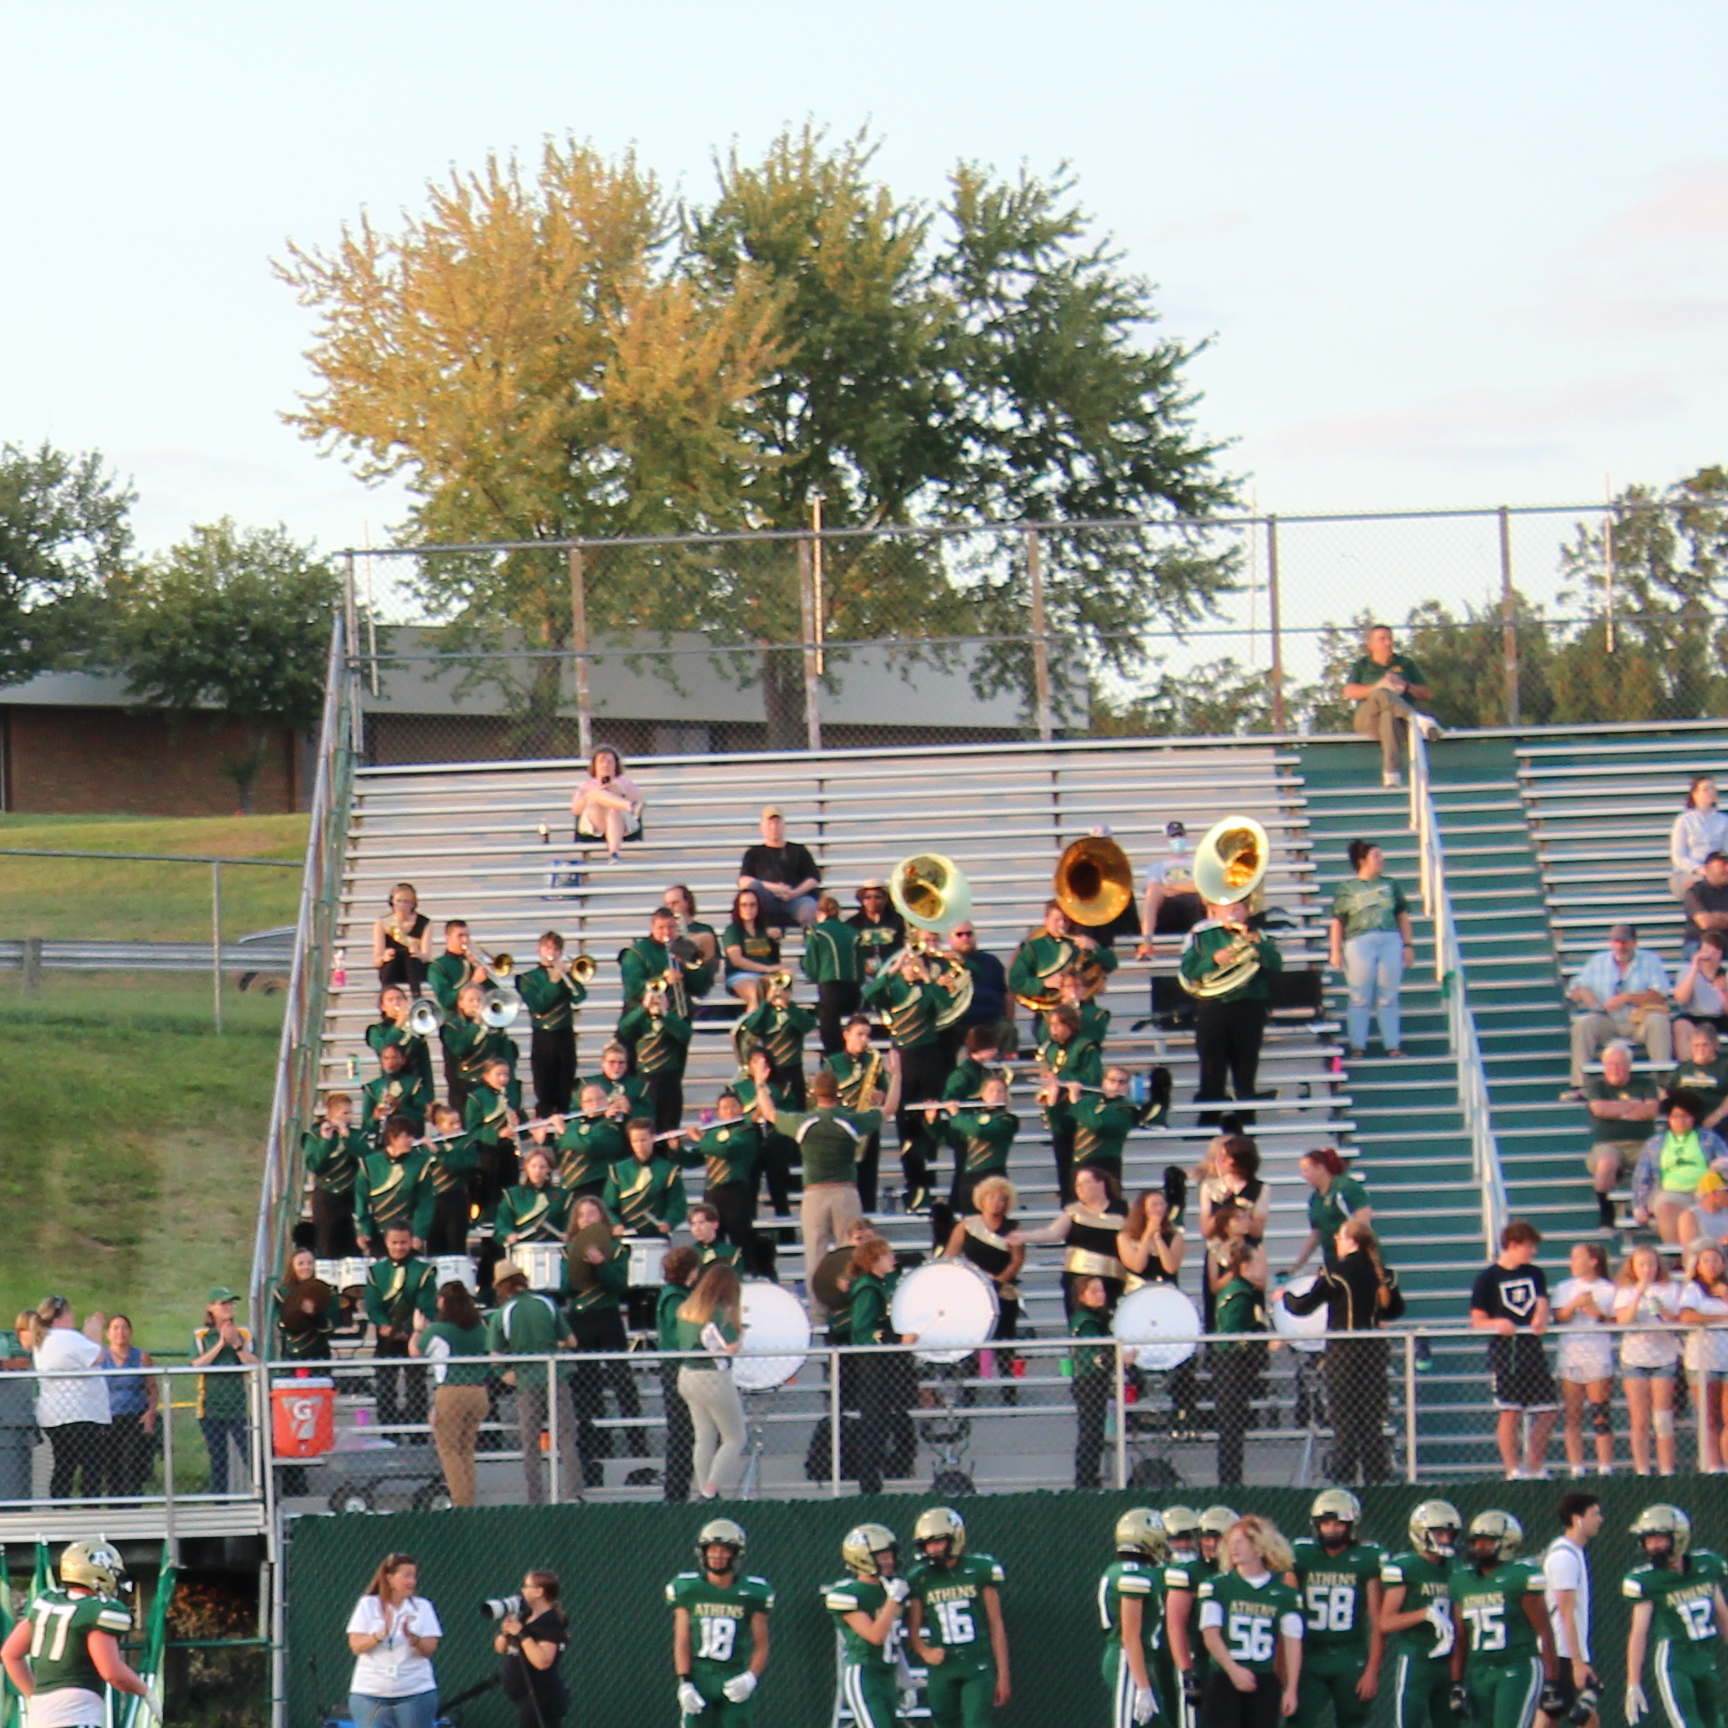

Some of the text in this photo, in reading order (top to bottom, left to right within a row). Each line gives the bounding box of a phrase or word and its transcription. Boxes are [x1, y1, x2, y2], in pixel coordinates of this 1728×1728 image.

[292, 1400, 313, 1420] G
[926, 1584, 977, 1604] ATHENS
[1308, 1572, 1356, 1586] ATHENS
[1666, 1583, 1714, 1607] ATHENS
[695, 1603, 744, 1618] ATHENS
[1230, 1600, 1277, 1617] ATHENS
[1306, 1586, 1355, 1631] 58
[1464, 1592, 1505, 1607] ATHENS
[32, 1598, 78, 1662] 77
[934, 1599, 975, 1644] 16
[1462, 1607, 1506, 1651] 75
[1677, 1597, 1717, 1641] 12
[698, 1617, 736, 1661] 18
[1229, 1614, 1274, 1661] 56
